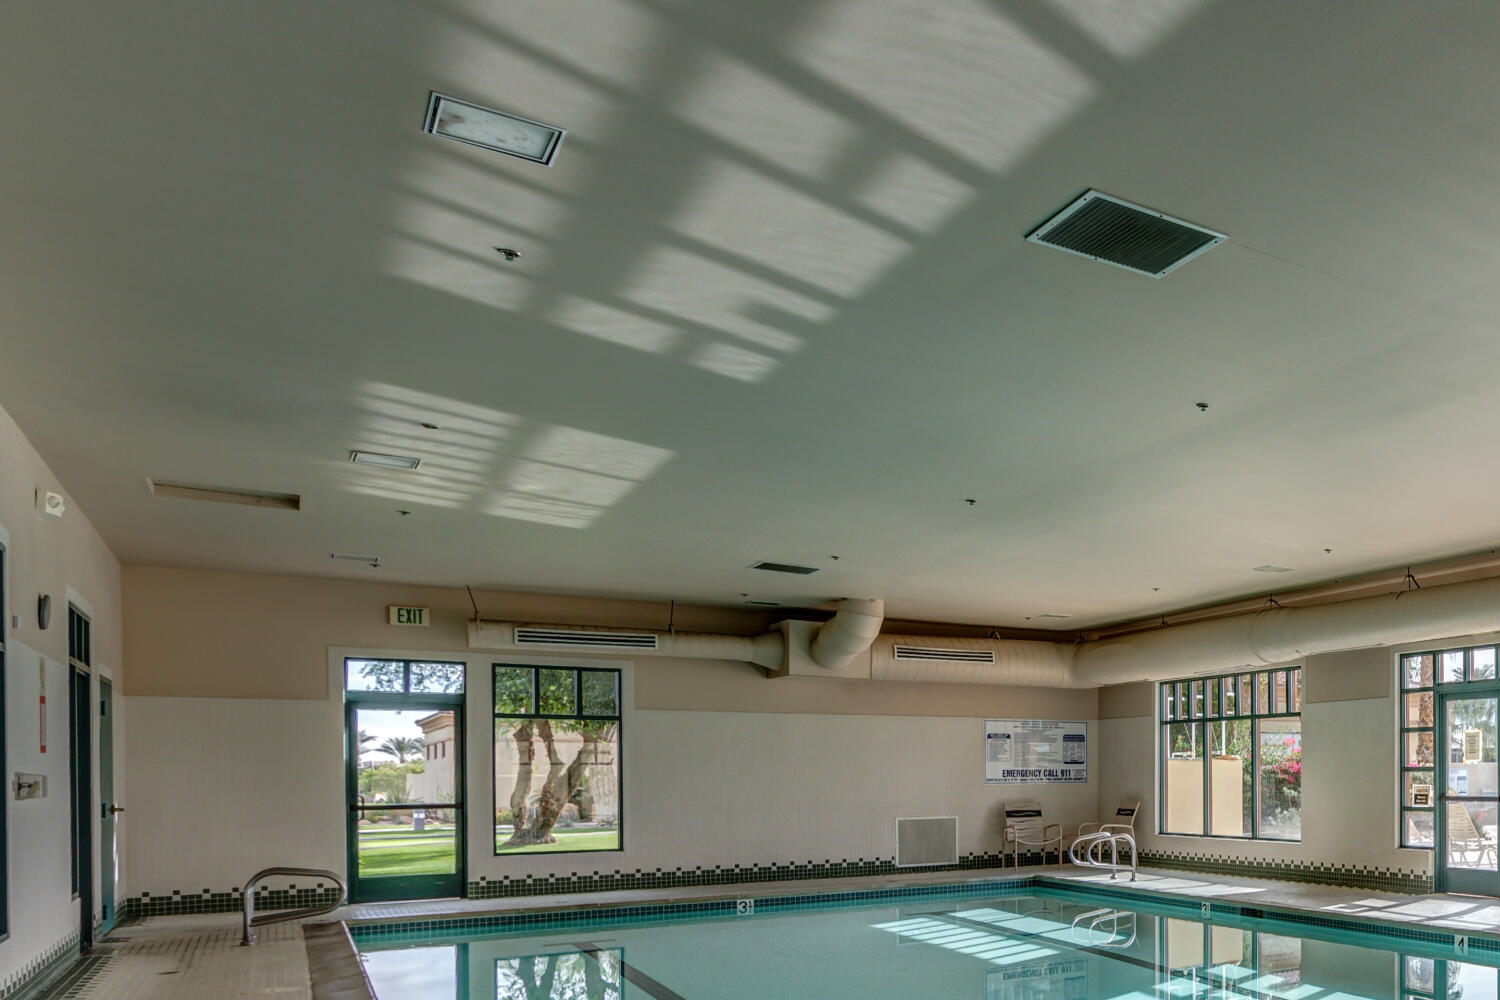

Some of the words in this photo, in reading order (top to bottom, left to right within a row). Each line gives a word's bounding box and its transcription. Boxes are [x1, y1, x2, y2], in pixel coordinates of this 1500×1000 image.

[397, 607, 424, 624] EXIT
[1002, 769, 1042, 777] EMERGENCY
[1043, 769, 1059, 777] CALL
[1060, 769, 1071, 777] 911
